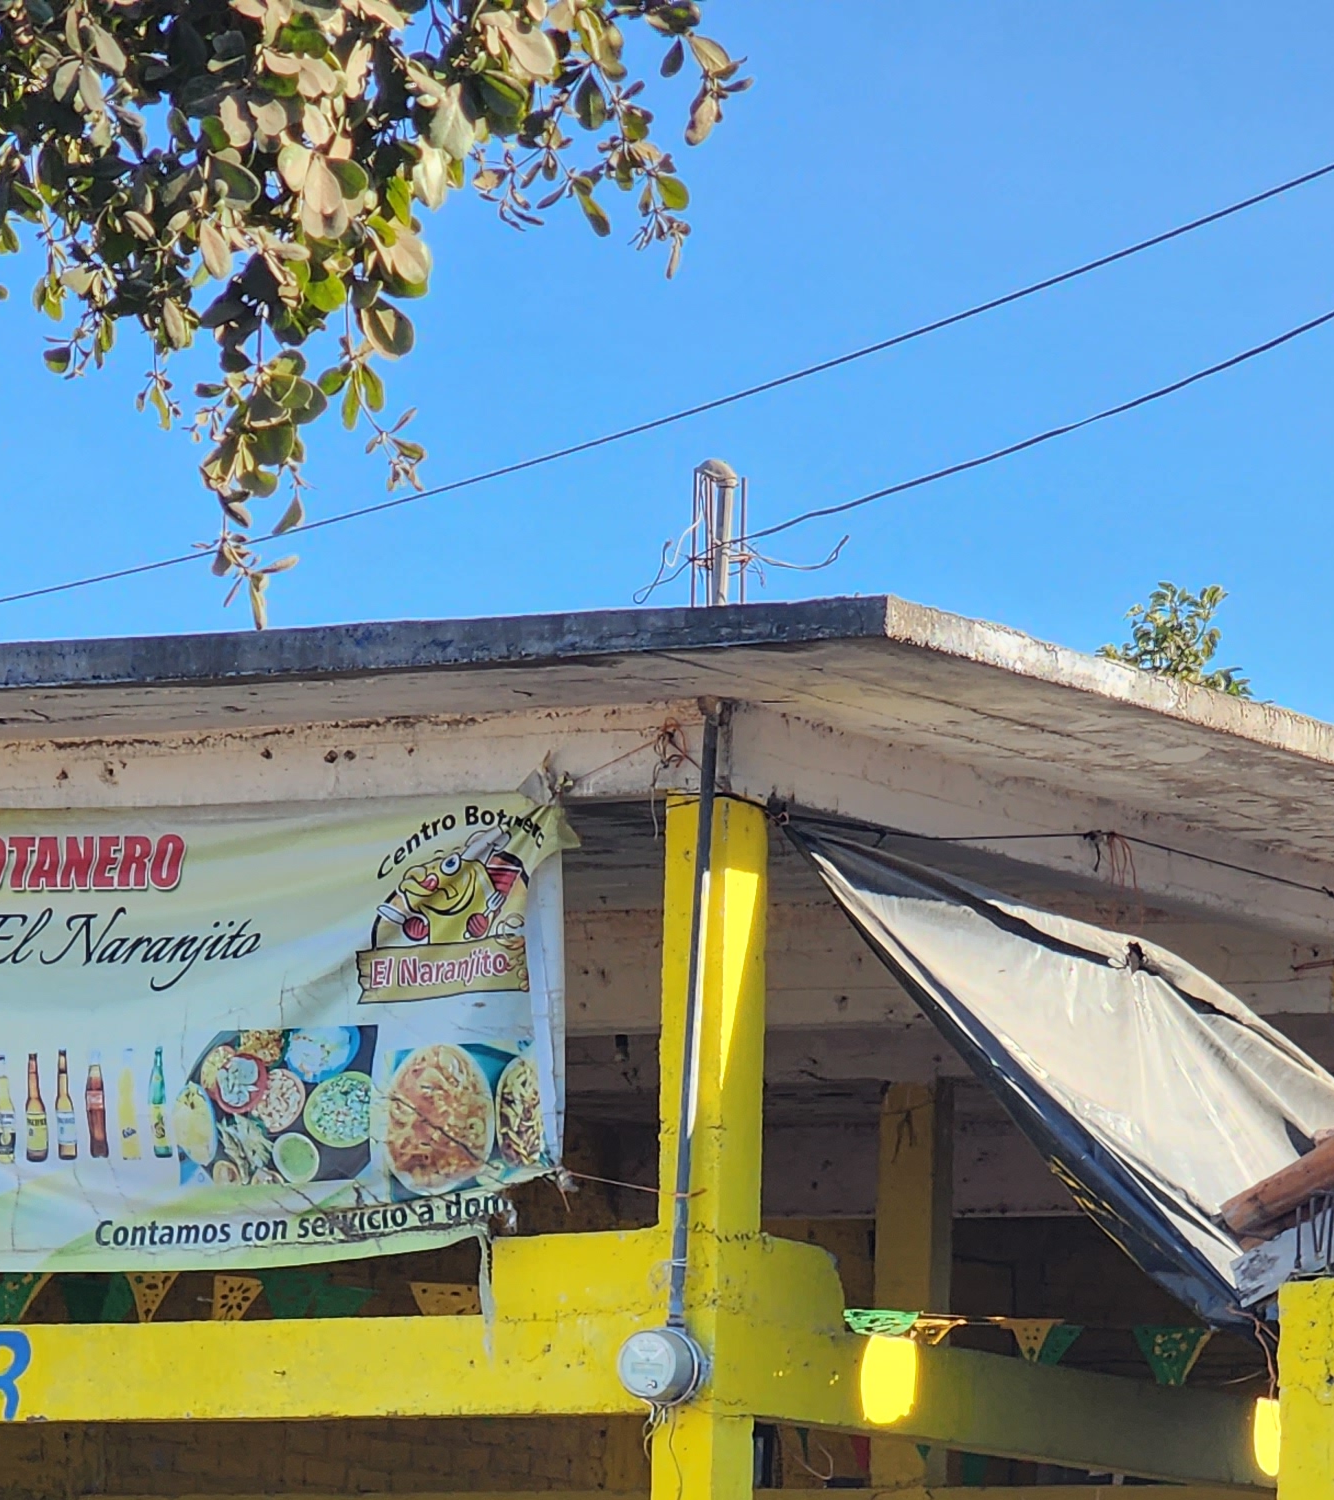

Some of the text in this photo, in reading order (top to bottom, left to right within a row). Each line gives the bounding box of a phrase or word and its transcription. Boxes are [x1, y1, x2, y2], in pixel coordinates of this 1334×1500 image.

[377, 814, 456, 880] Centro
[39, 906, 262, 992] Naranjito
[371, 949, 511, 989] El Naranjito
[95, 1217, 231, 1248] Contamos
[240, 1217, 288, 1241] con
[418, 1201, 436, 1224] a
